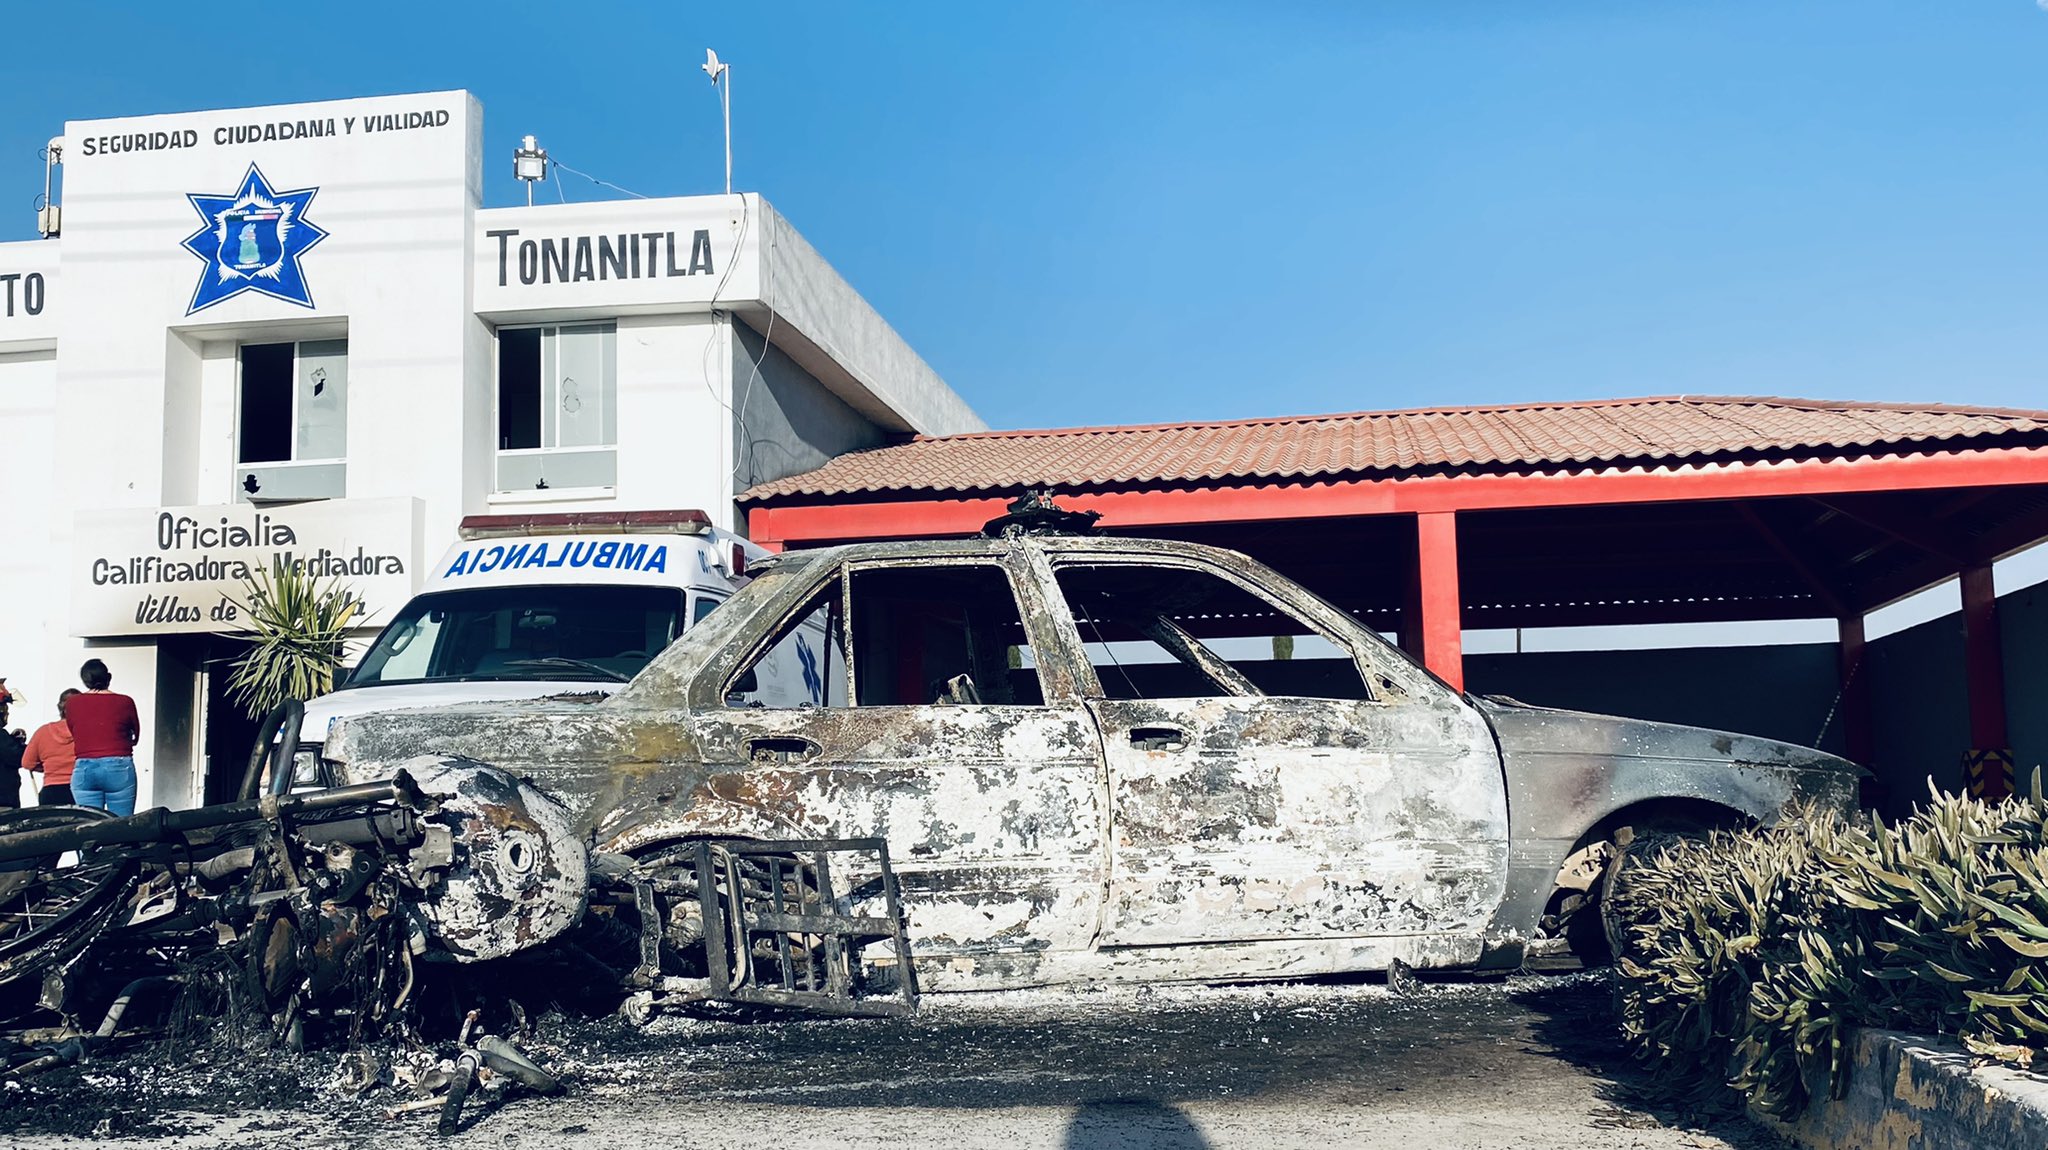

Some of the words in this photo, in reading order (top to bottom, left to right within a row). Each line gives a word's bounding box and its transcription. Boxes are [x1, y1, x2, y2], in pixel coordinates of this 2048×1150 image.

[83, 129, 198, 156] SEGURIDAD
[213, 118, 336, 146] CIUDADANA
[343, 117, 356, 135] Y
[363, 109, 450, 133] VIALIDAD
[486, 229, 714, 286] TONANITLA
[158, 511, 297, 550] Oficialia
[92, 555, 250, 586] Calificadora
[136, 594, 201, 625] Villas
[211, 598, 237, 621] de
